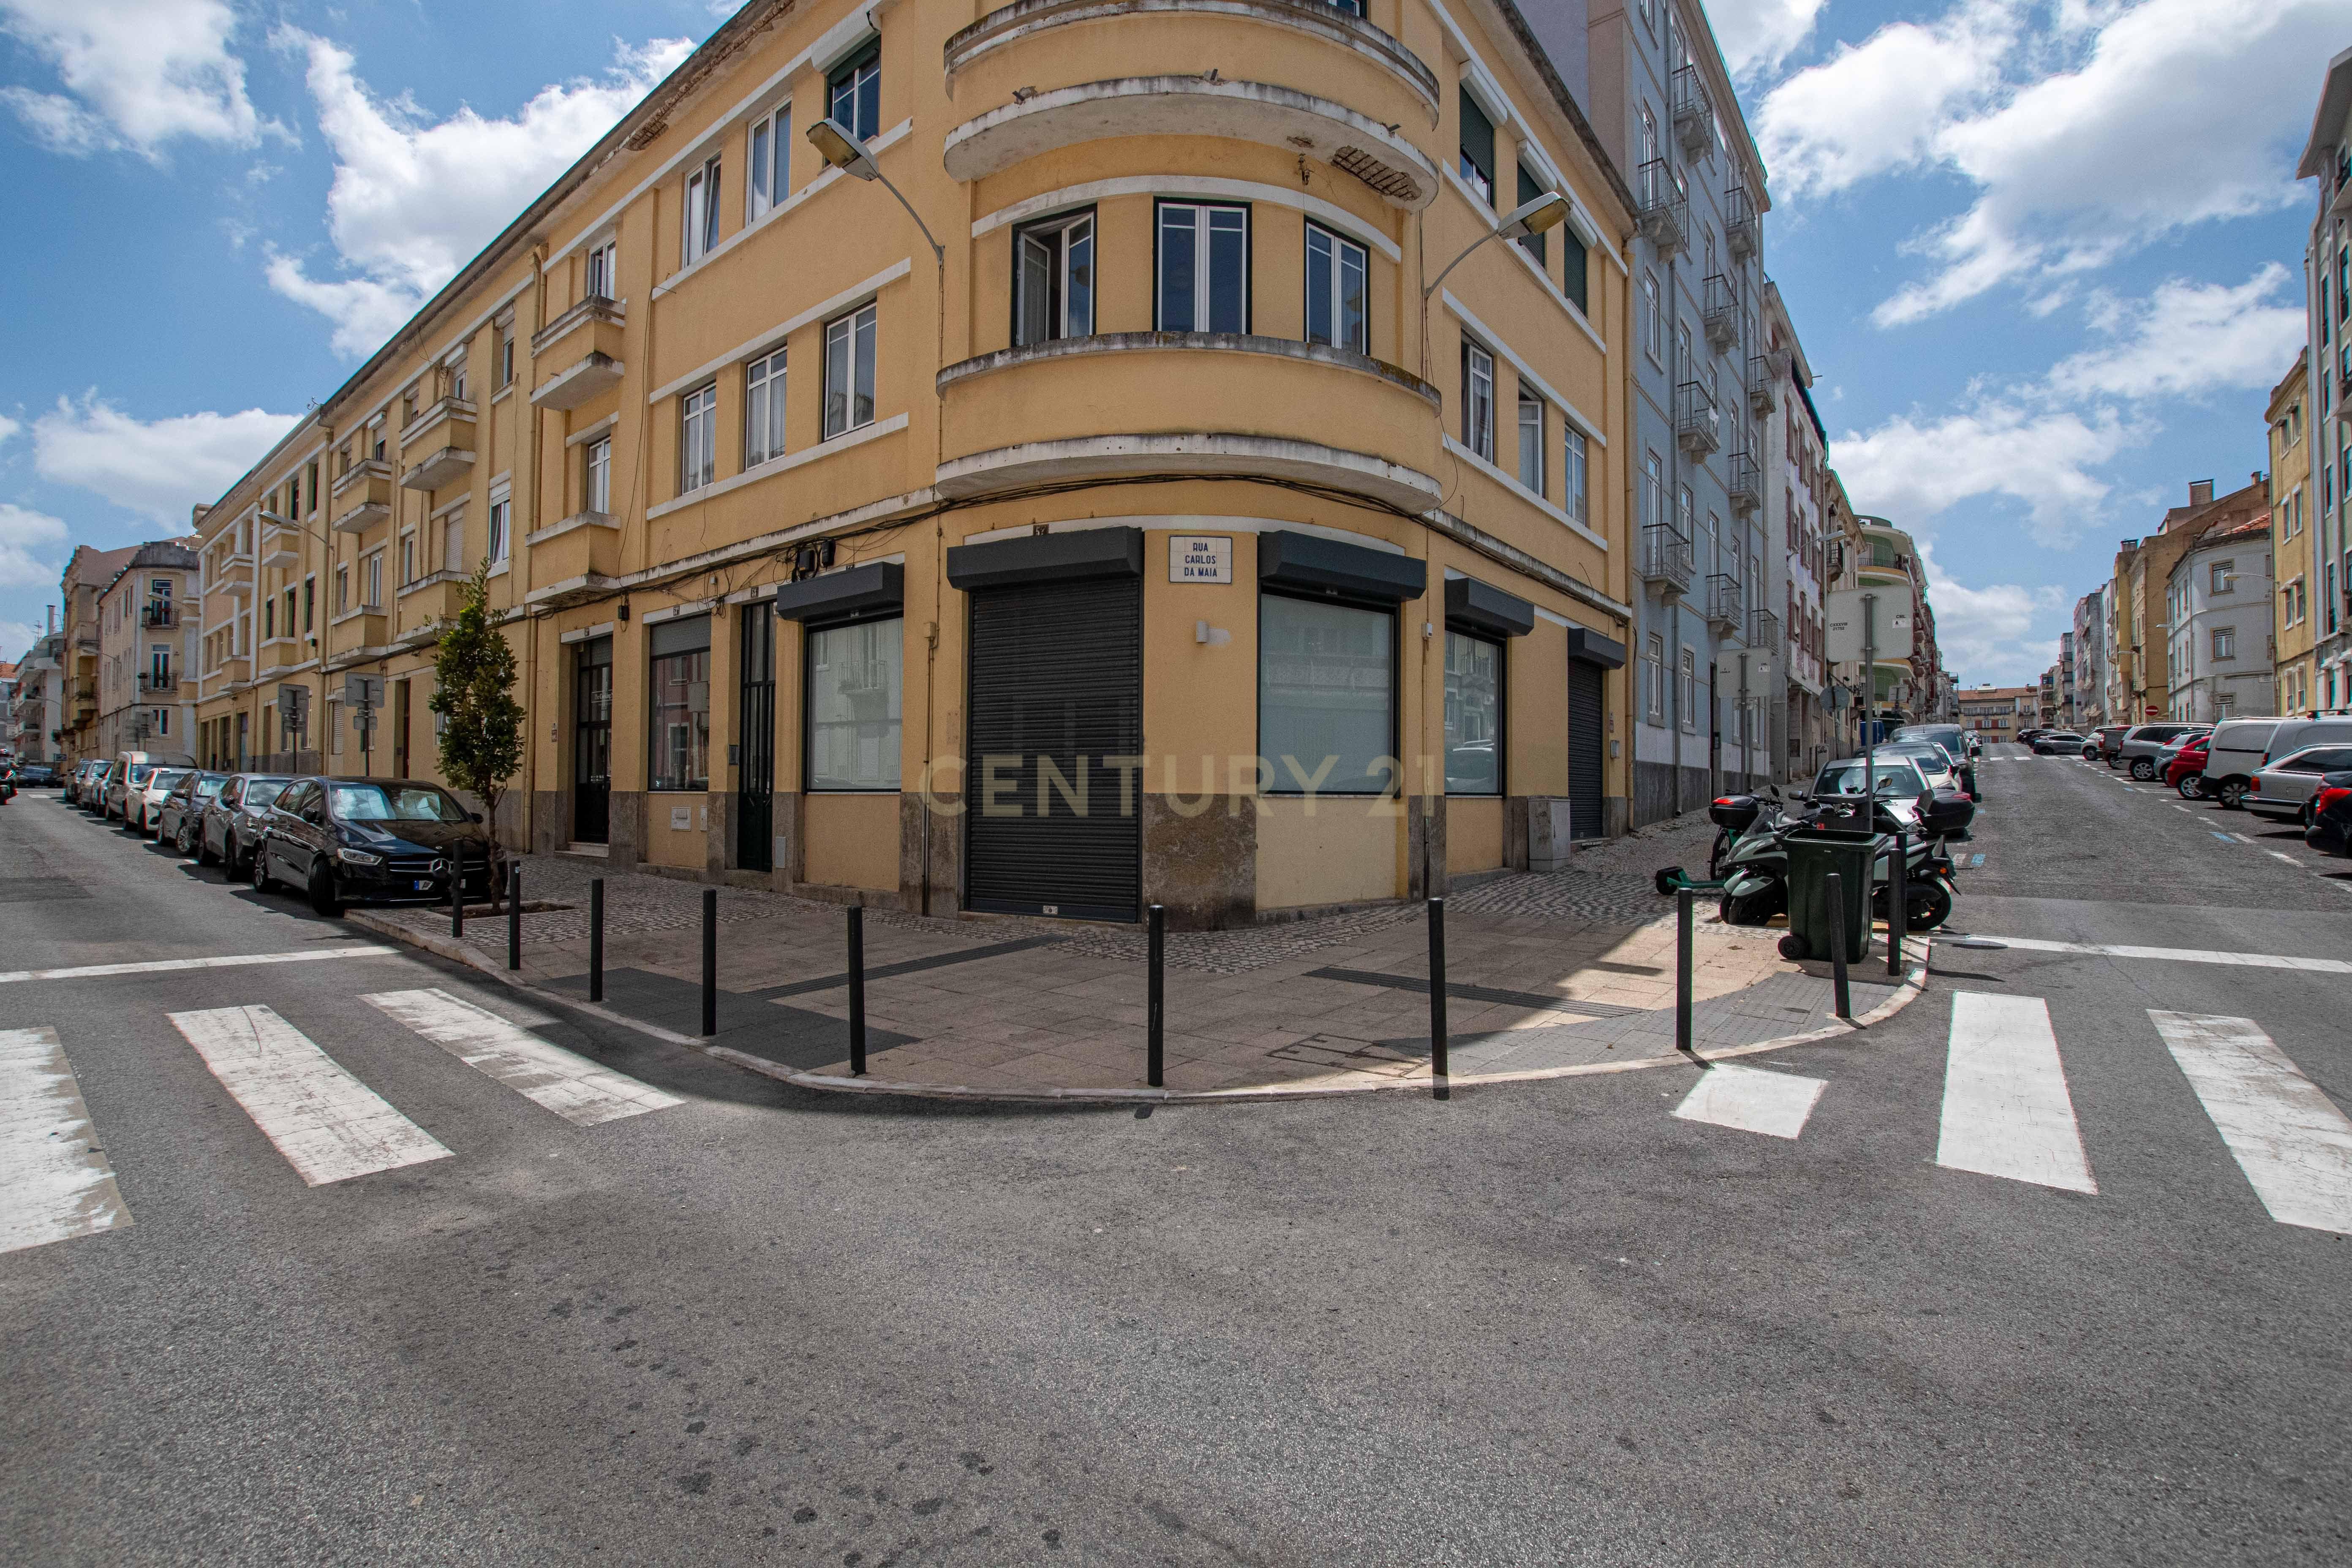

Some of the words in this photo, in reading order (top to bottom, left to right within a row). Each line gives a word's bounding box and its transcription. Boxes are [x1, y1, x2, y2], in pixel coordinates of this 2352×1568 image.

[1193, 542, 1208, 551] RUA
[1185, 555, 1216, 564] CARLOS
[1184, 567, 1195, 576] DA
[1198, 568, 1217, 577] MAIA
